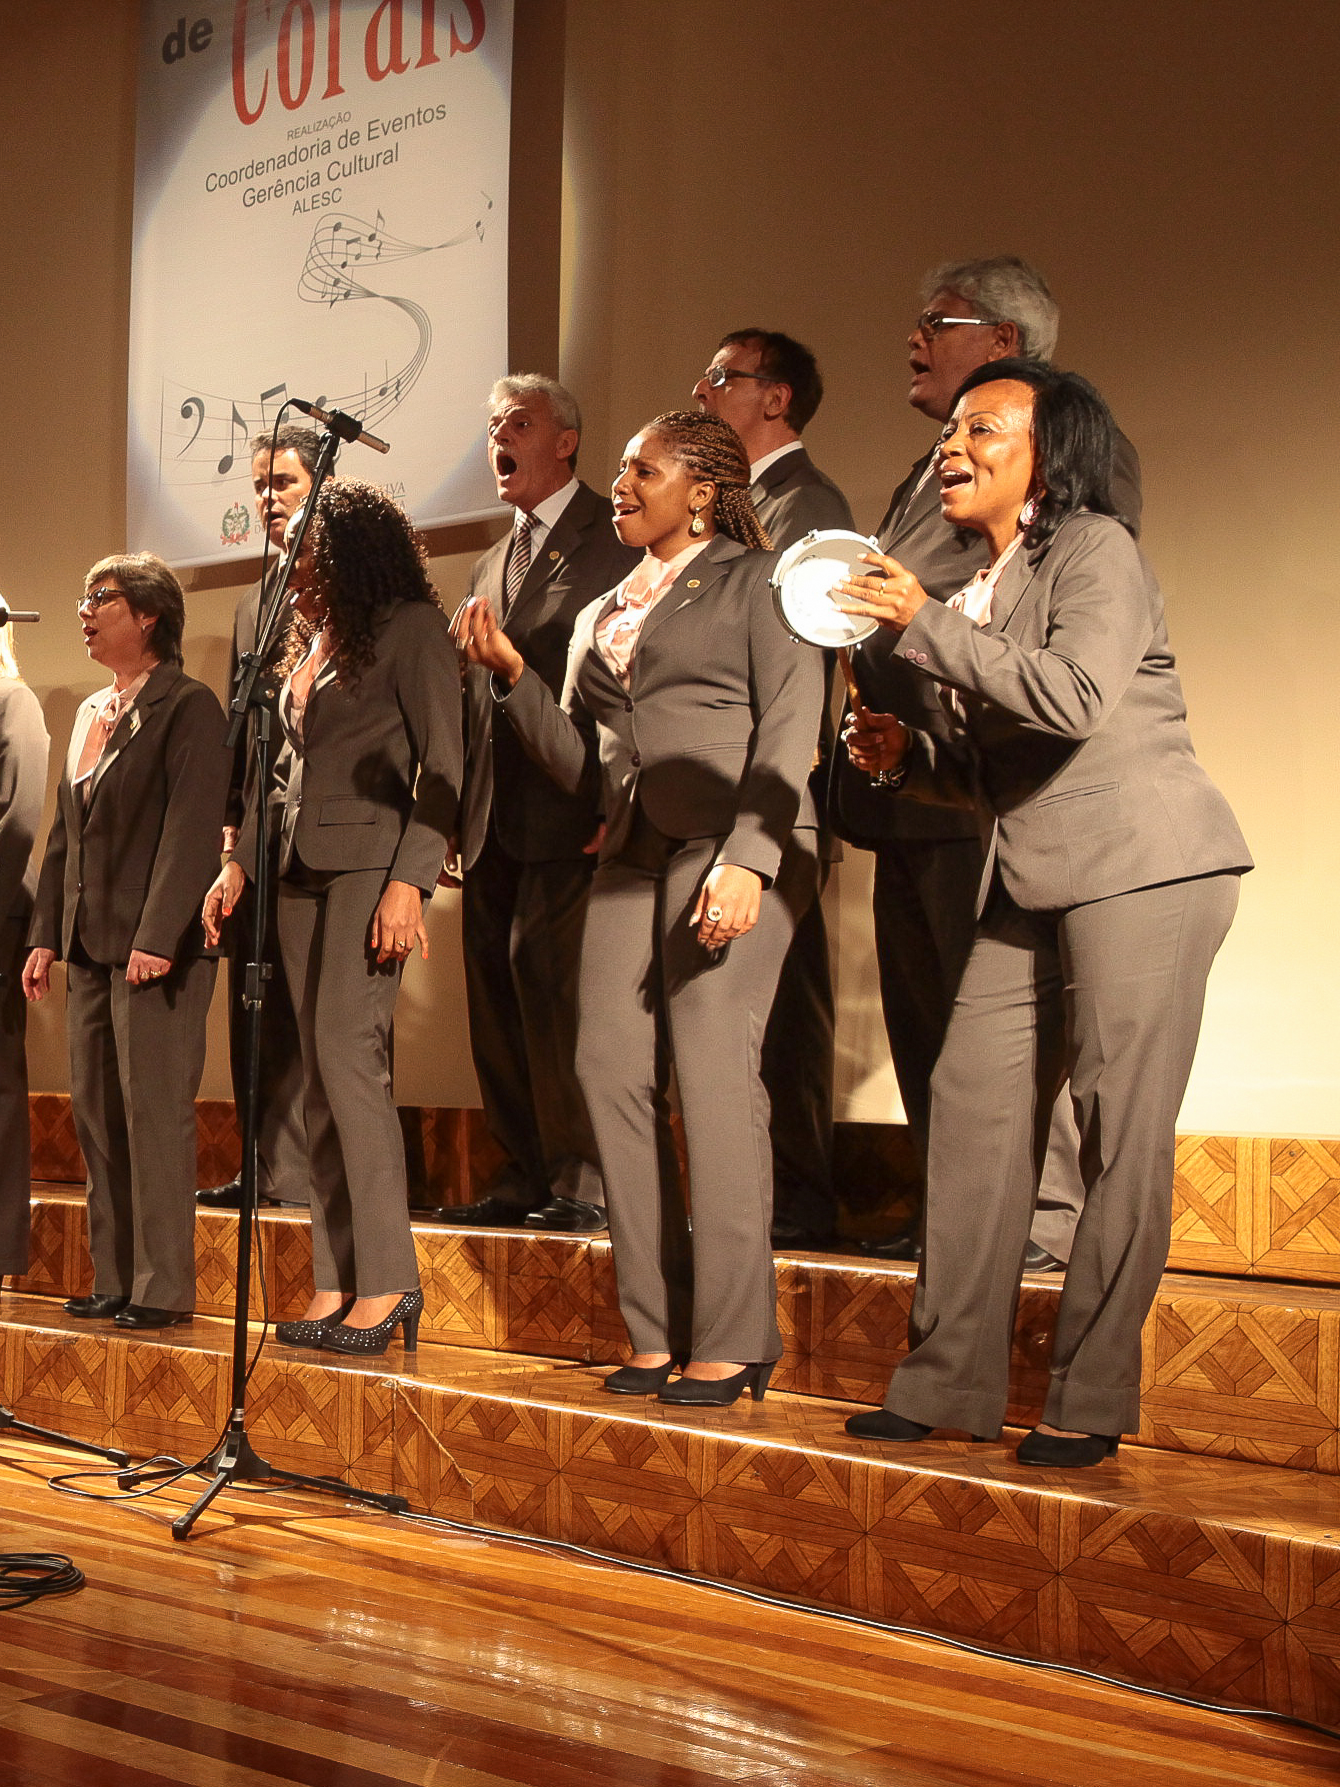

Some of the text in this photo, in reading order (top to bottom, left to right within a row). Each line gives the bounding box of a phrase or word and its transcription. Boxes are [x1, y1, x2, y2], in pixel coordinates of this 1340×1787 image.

[162, 16, 214, 65] de
[205, 103, 447, 193] Coordenadoria de Eventos
[242, 141, 399, 208] Gerência Cultural
[292, 187, 343, 216] ALESC
